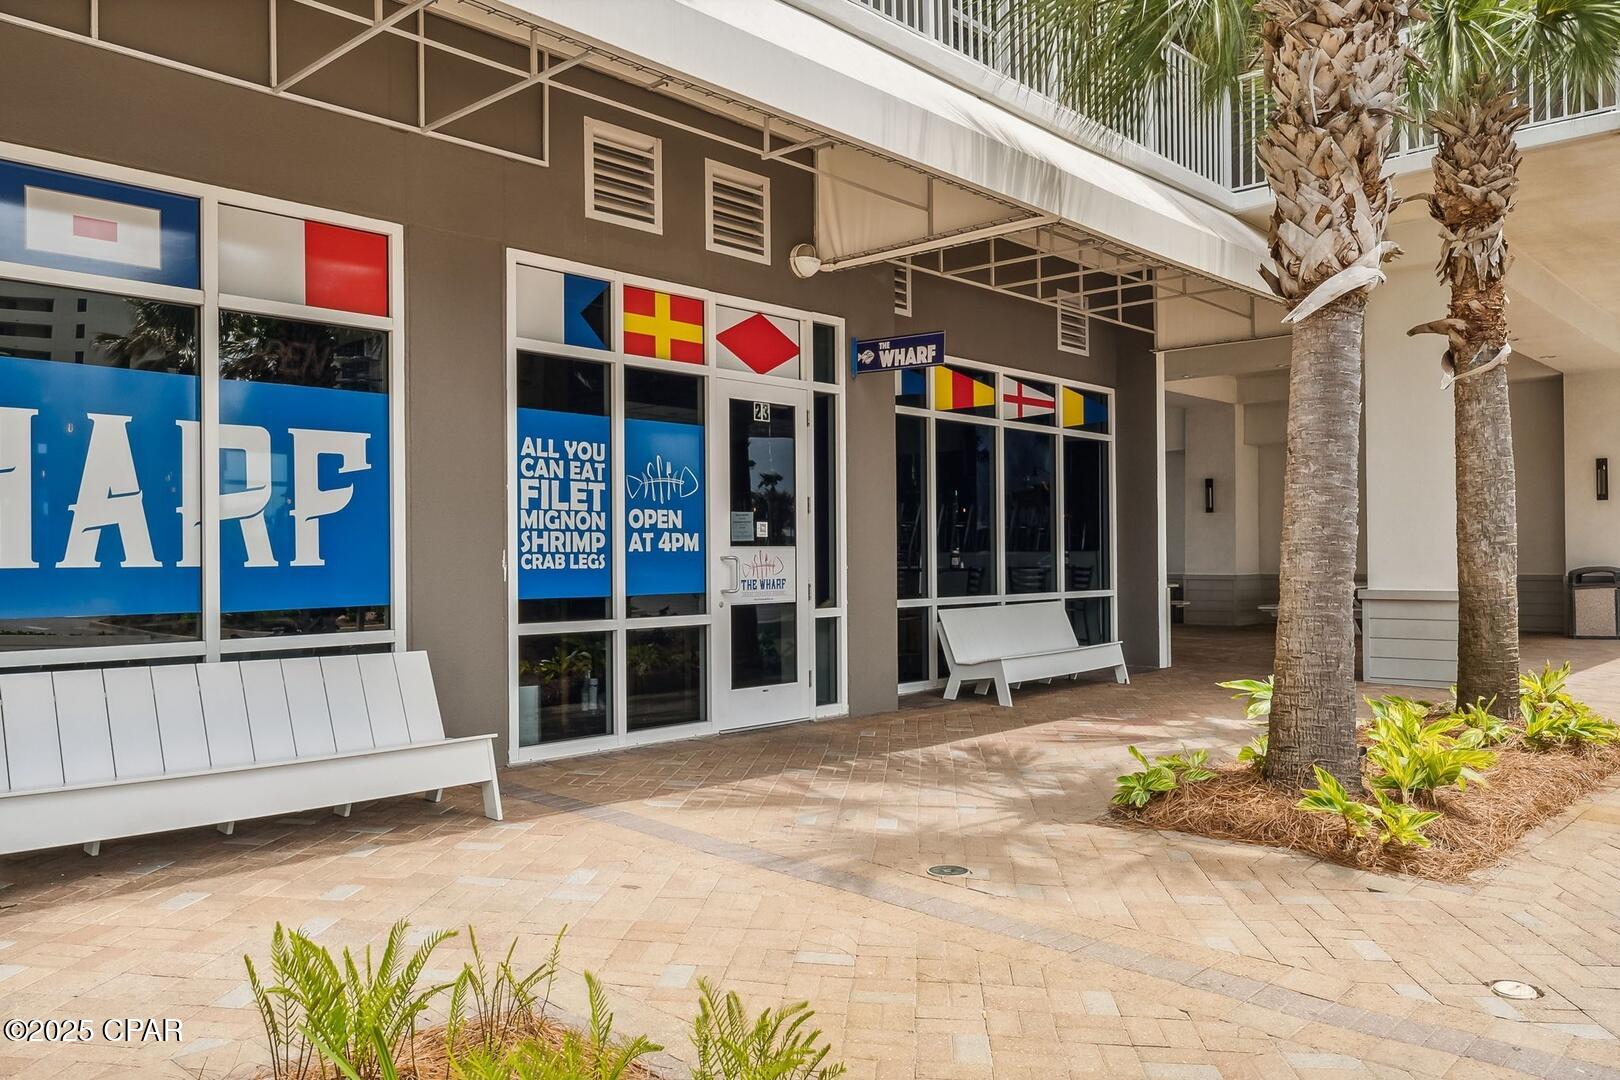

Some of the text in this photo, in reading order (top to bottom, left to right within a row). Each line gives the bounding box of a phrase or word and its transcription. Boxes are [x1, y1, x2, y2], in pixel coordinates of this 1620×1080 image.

[878, 341, 891, 350] THE
[878, 344, 936, 368] WHARF
[755, 403, 769, 421] 23
[520, 437, 606, 461] ALL YOU
[520, 458, 606, 481] CAN EAT
[520, 478, 606, 512] FILET
[520, 510, 606, 530] MIGNON
[628, 508, 683, 529] OPEN
[520, 530, 606, 553] SHRIMP
[628, 531, 700, 553] AT 4PM
[520, 553, 606, 570] CRAB LEGS
[741, 578, 786, 591] THE WHARF
